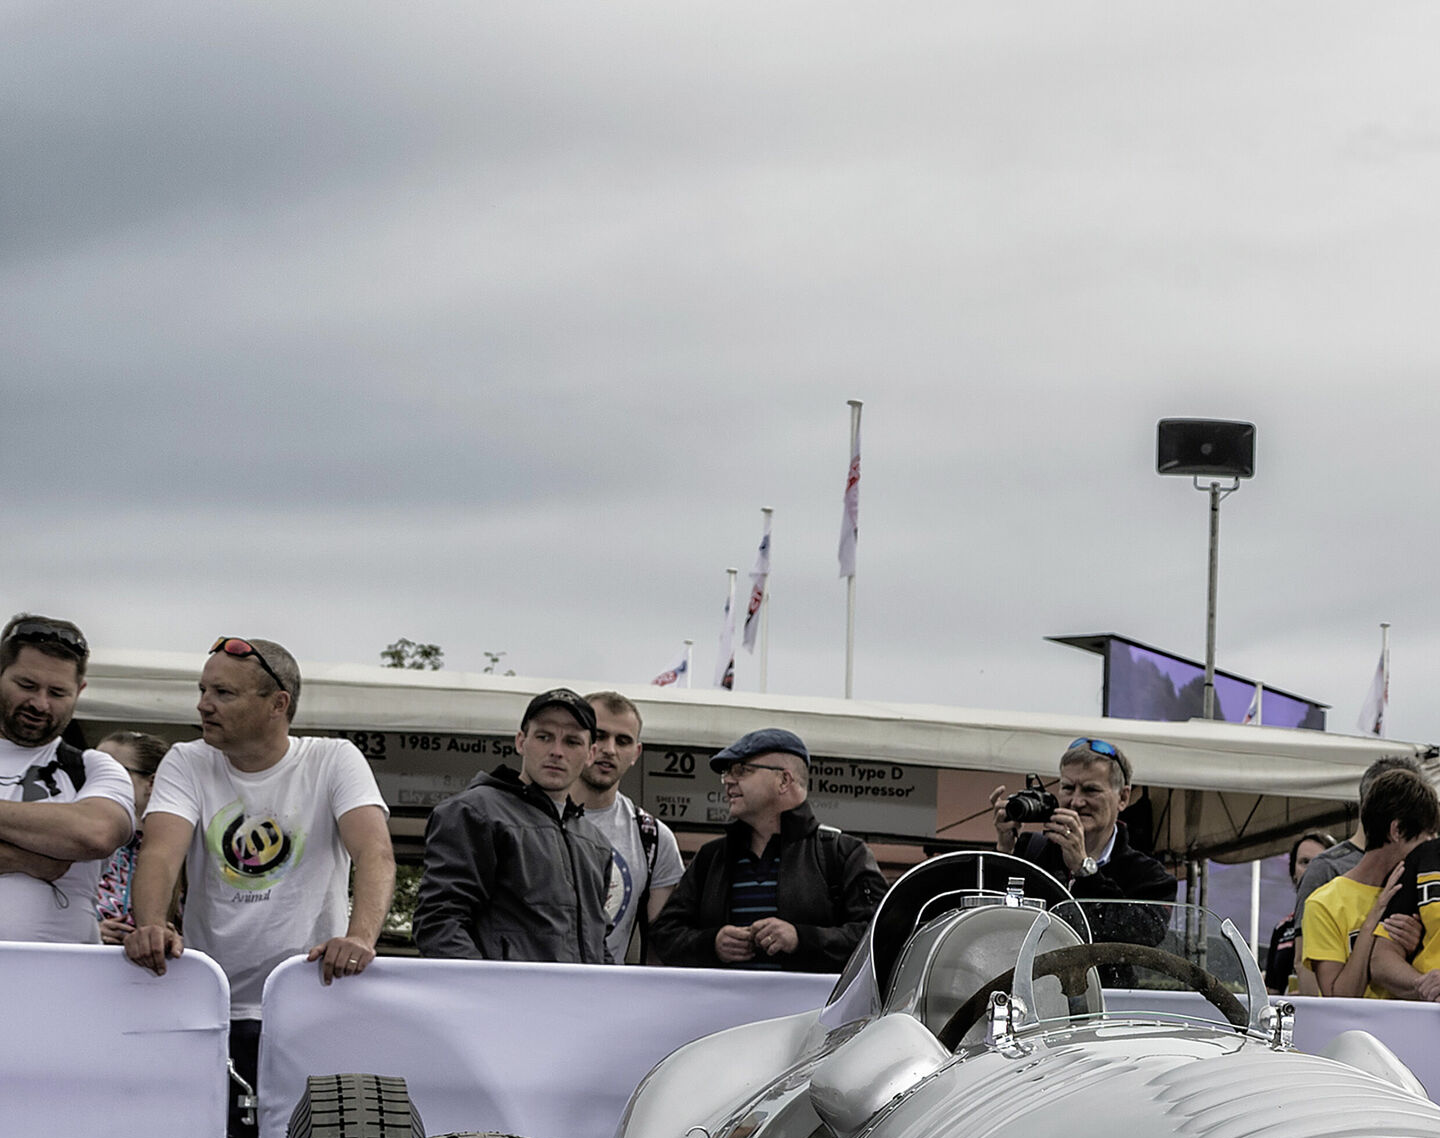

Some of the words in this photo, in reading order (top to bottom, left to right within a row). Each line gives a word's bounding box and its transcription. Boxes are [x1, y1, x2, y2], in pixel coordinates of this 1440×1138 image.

[400, 734, 441, 750] 1985
[446, 737, 487, 754] Audi
[664, 751, 696, 774] 20
[808, 761, 845, 777] nion
[848, 764, 887, 781] Type
[891, 766, 904, 780] D
[656, 795, 691, 804] SHELTER
[658, 803, 688, 817] 217
[231, 888, 272, 904] Animal
